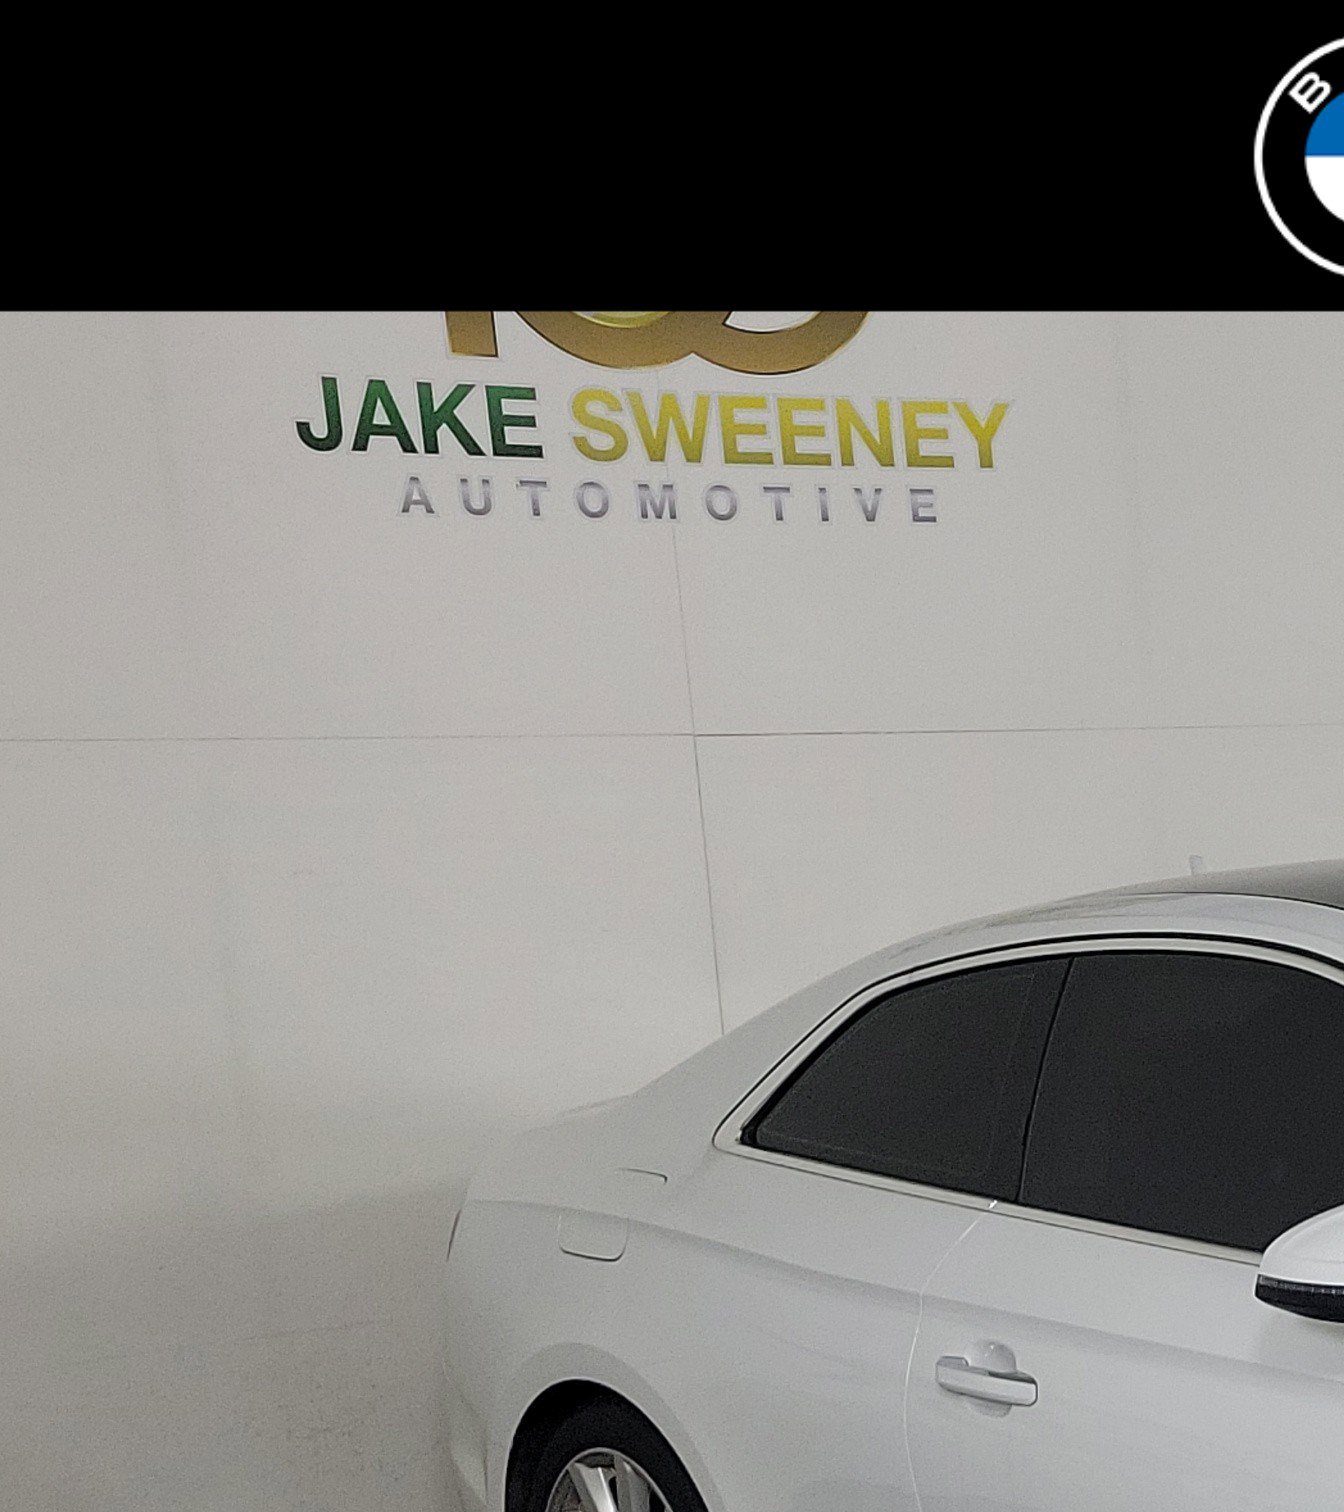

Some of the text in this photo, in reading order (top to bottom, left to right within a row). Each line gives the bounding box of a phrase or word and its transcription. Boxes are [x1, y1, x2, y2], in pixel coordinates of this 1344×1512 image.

[296, 375, 1011, 469] JAKE SWEENEY
[400, 474, 940, 524] AUTOMOTIVE
